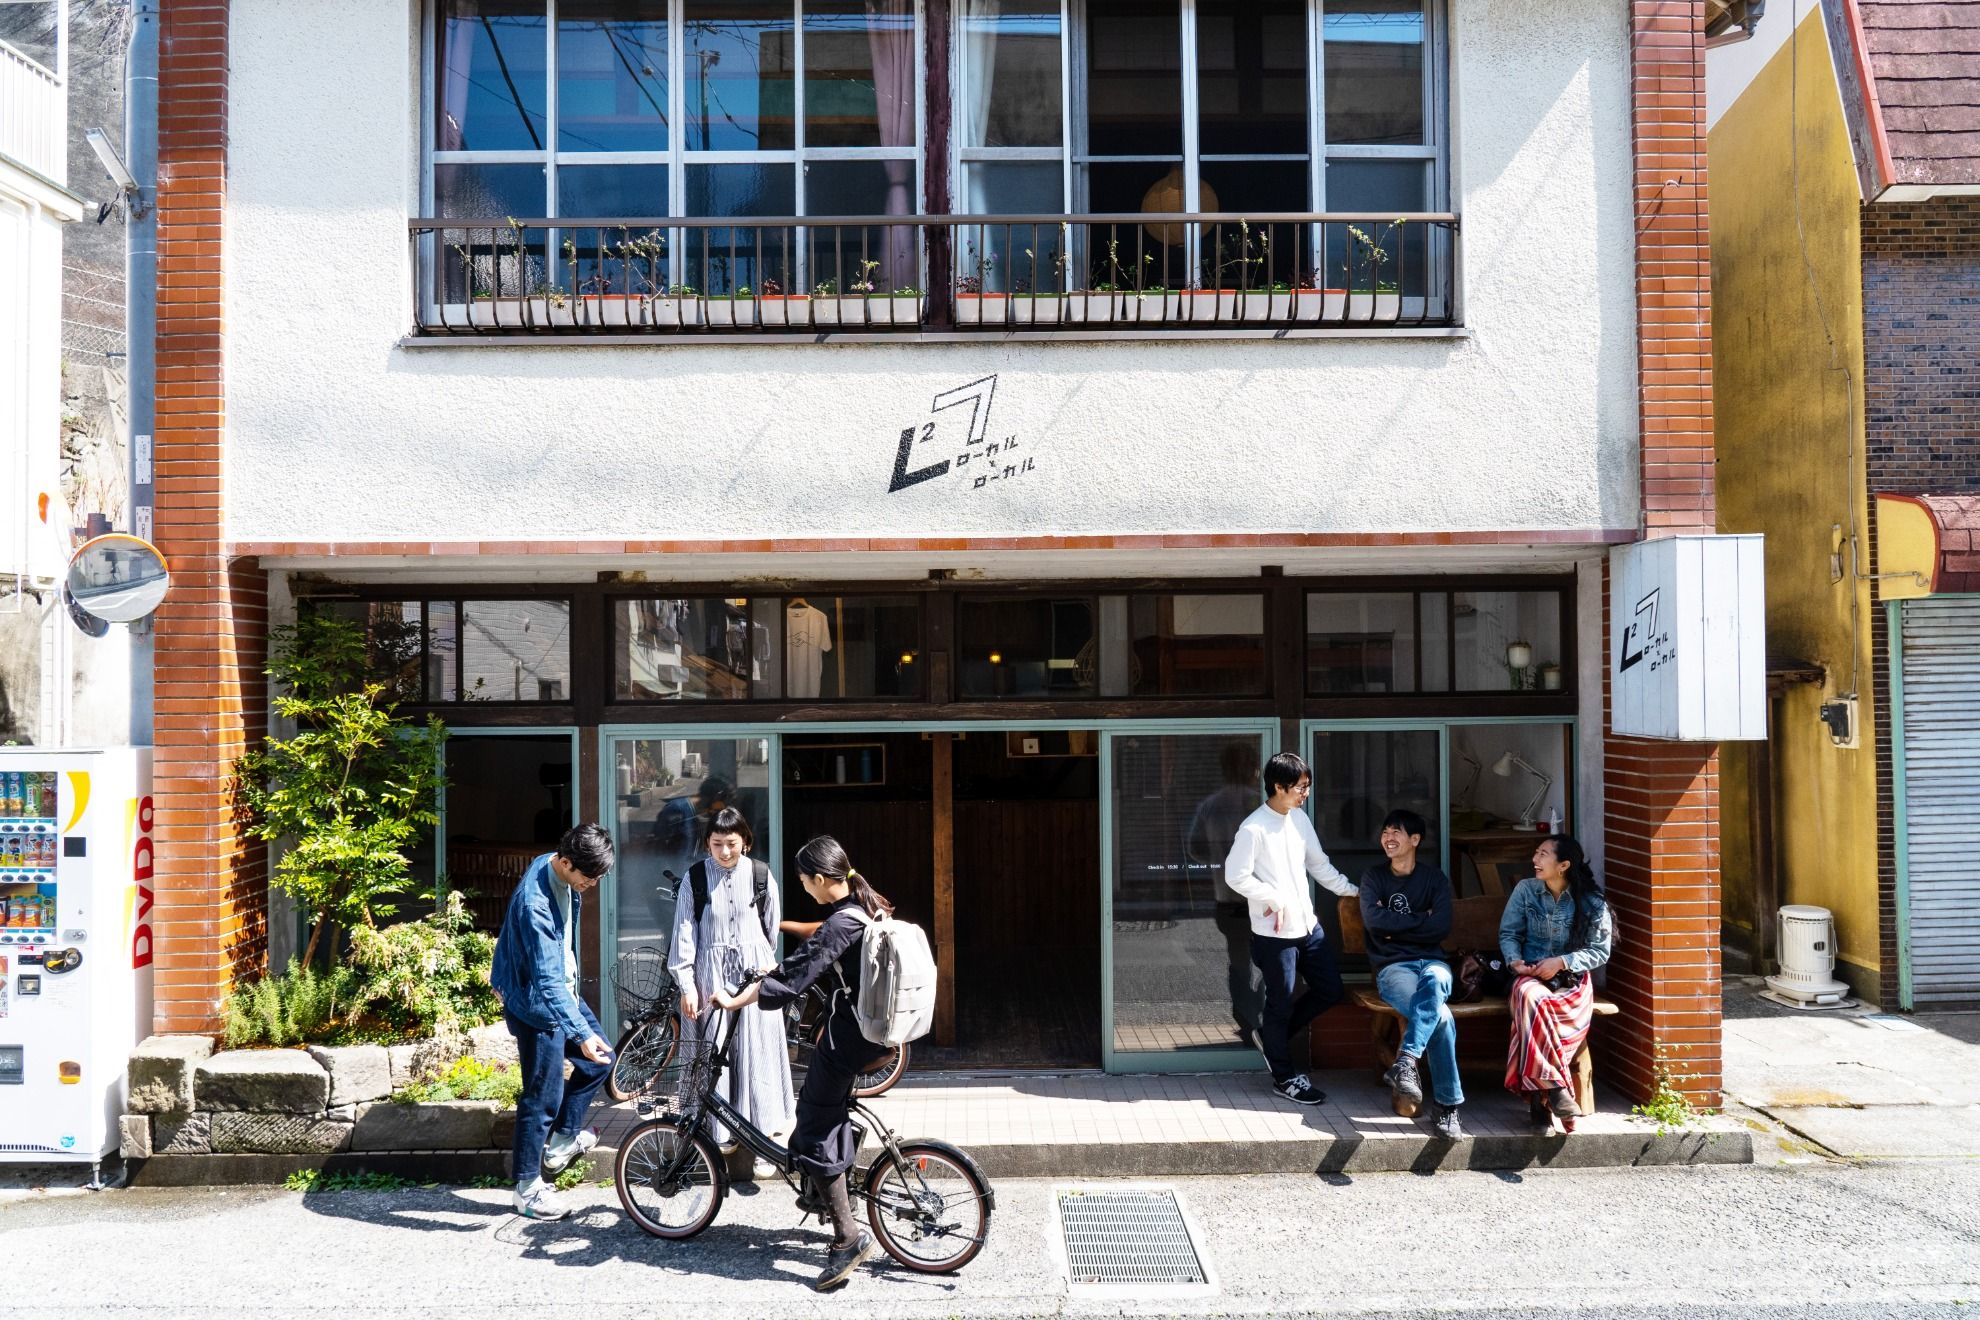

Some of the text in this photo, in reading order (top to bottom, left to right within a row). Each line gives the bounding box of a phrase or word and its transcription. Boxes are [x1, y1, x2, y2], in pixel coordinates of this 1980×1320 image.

[956, 435, 1018, 467] ローカル
[973, 457, 1035, 489] ローカル
[1644, 632, 1668, 655] ローカル
[1651, 648, 1675, 671] ローカル
[1285, 1084, 1301, 1098] N
[717, 1106, 740, 1129] Peltech
